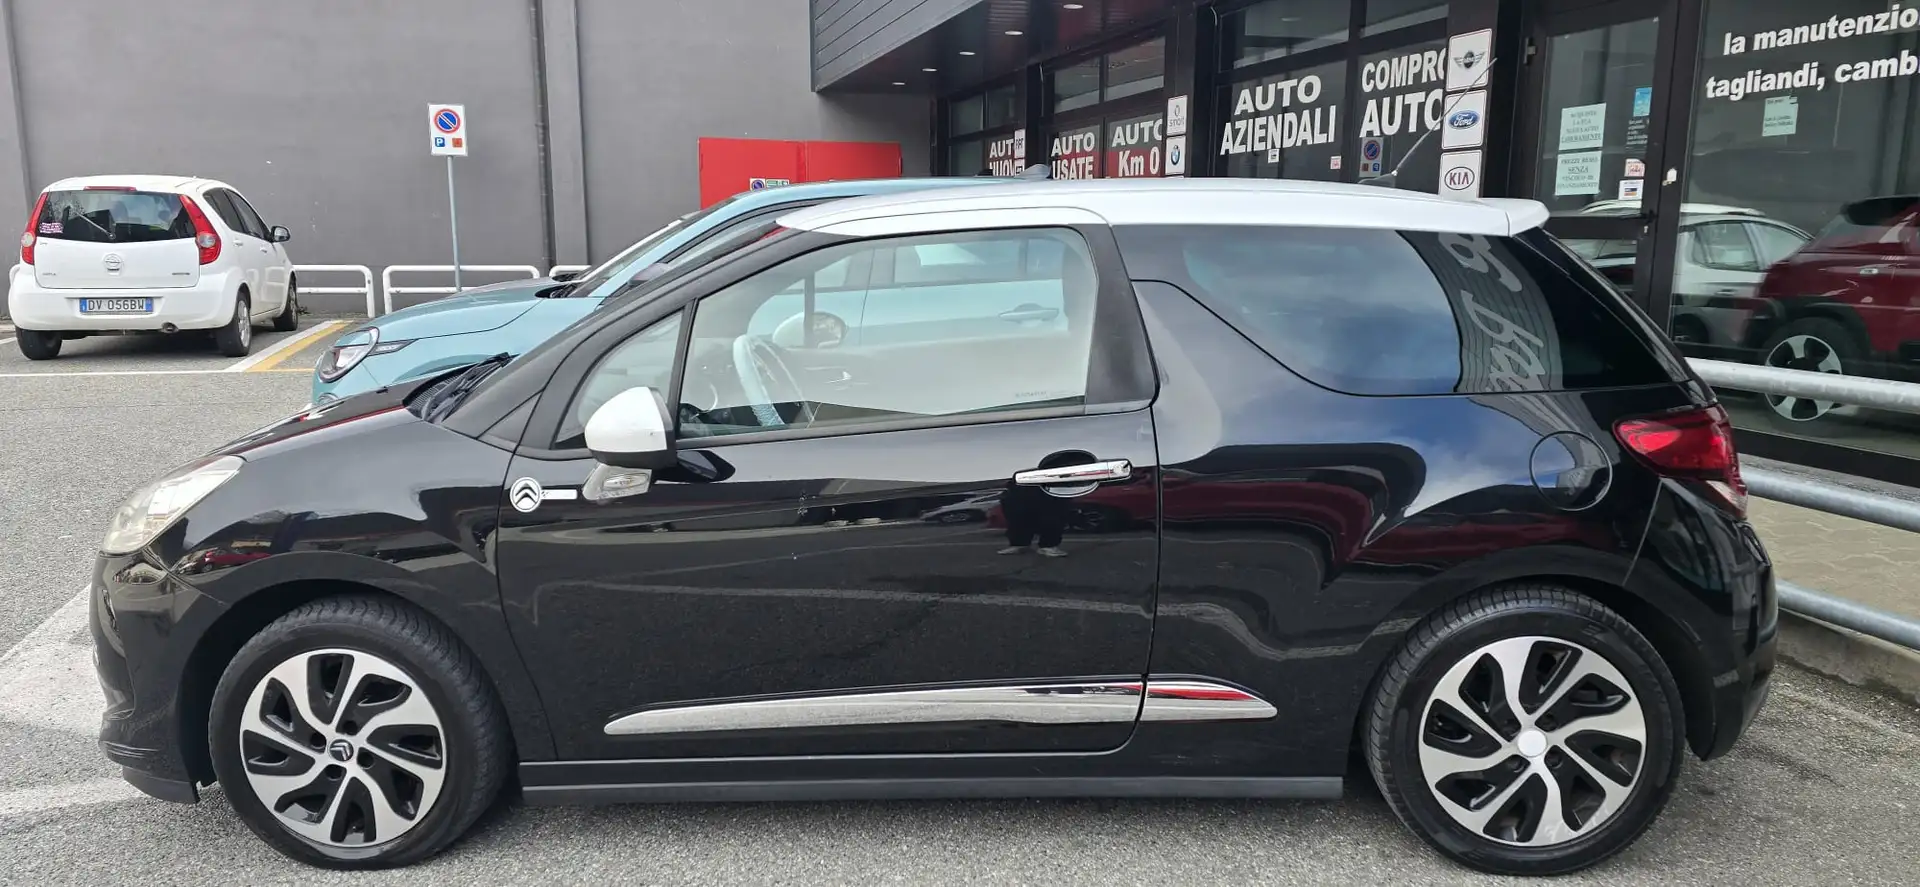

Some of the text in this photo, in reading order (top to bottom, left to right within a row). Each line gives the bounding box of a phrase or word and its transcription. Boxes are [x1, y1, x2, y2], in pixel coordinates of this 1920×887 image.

[1722, 4, 1920, 56] la manutenzio
[1706, 49, 1920, 101] tagliandi, camb
[1234, 75, 1322, 116] AUTO
[1359, 88, 1444, 138] AUTO
[1453, 112, 1474, 127] Ford
[1051, 131, 1096, 157] AUTO
[1219, 105, 1337, 156] AZIENDALI
[989, 138, 1014, 159] AUT
[1118, 146, 1160, 177] Km 0
[1052, 155, 1095, 180] USATE
[1450, 171, 1470, 186] KIA
[88, 299, 144, 311] DV 056BW
